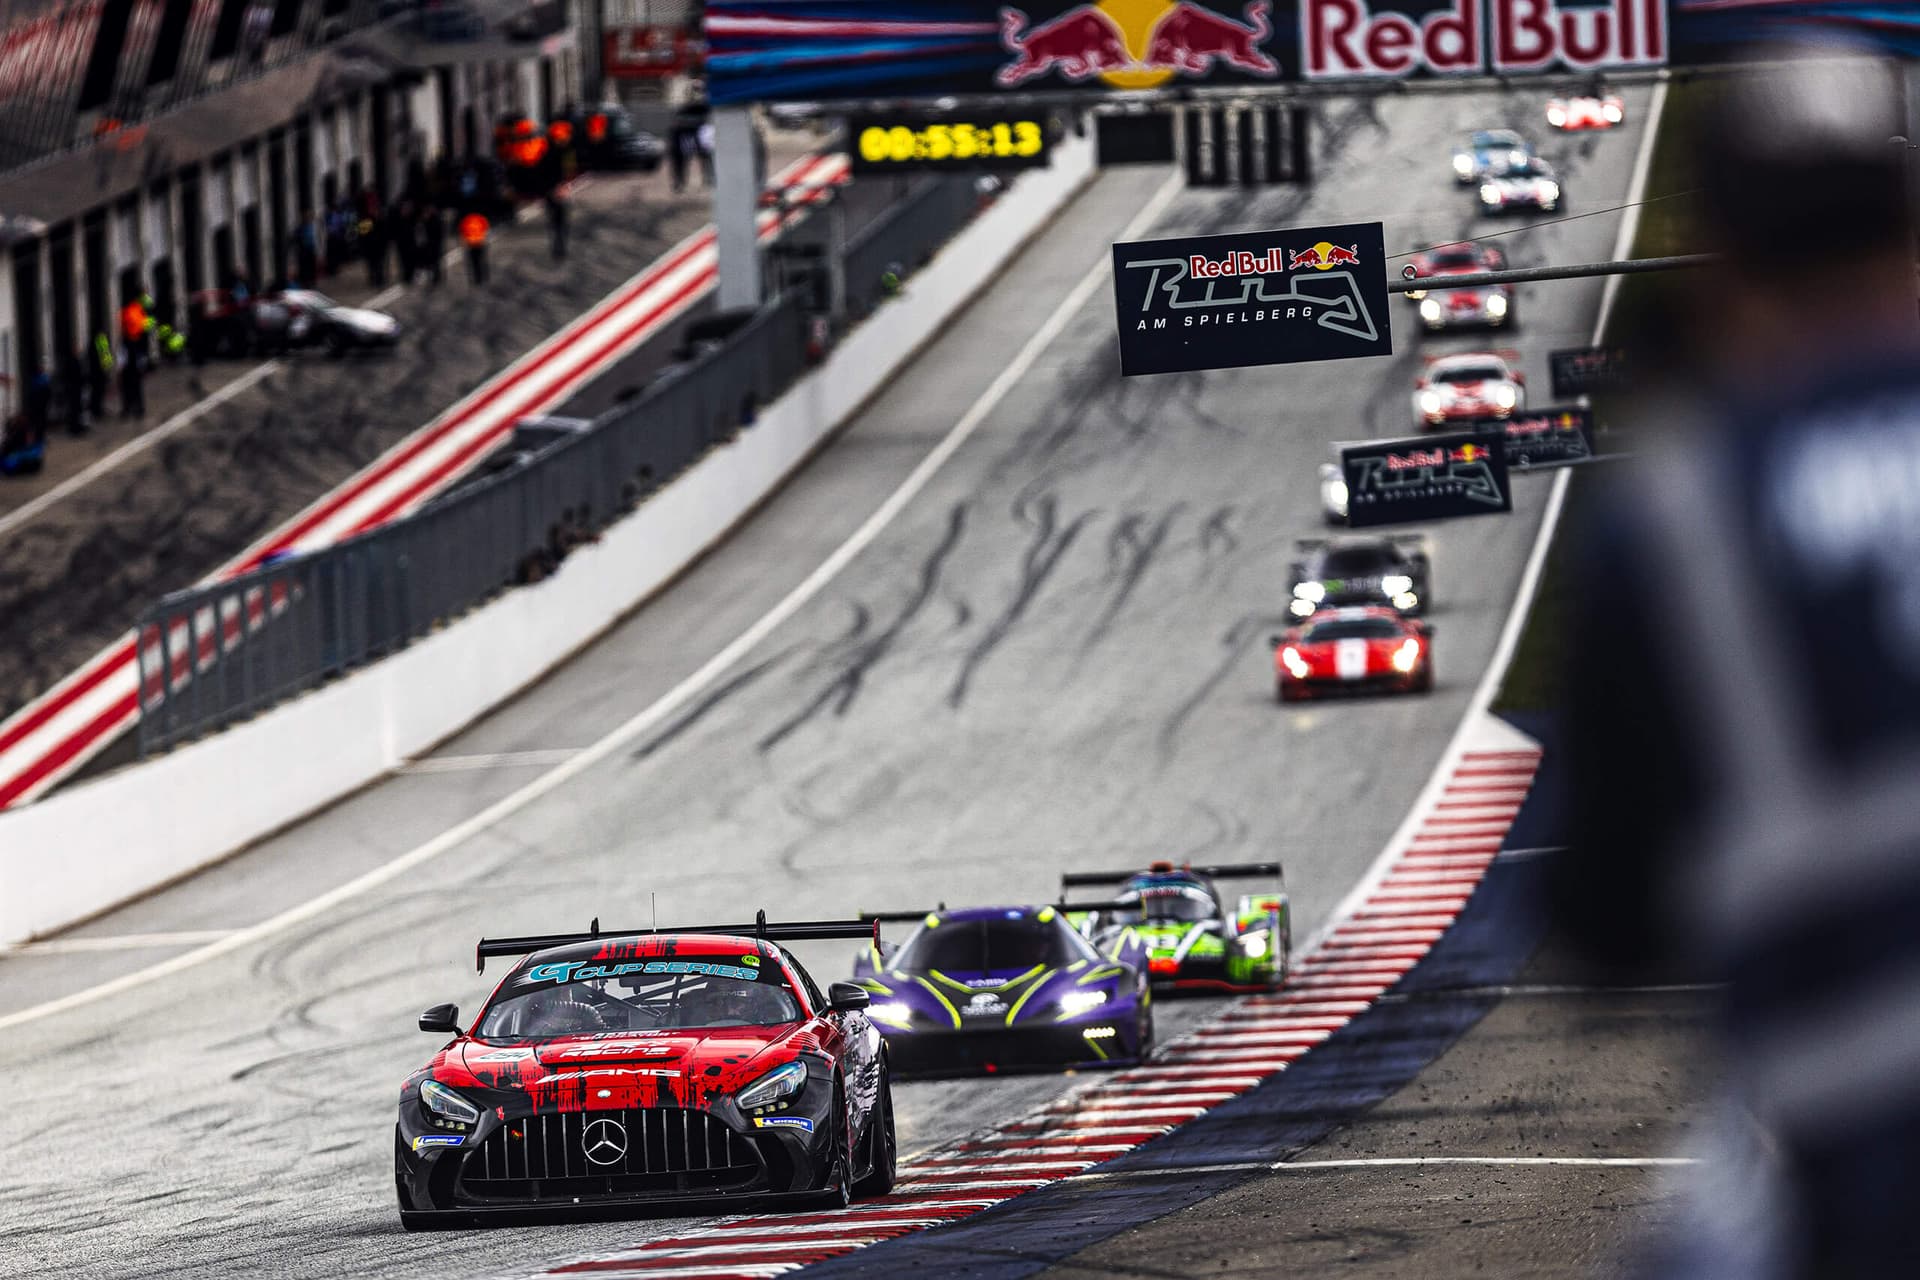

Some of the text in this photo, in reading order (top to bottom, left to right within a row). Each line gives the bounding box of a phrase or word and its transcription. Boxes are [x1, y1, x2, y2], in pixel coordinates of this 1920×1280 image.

[1304, 0, 1664, 74] Red Bull
[860, 121, 1042, 161] 00:55:13
[1190, 248, 1283, 279] Red Bull
[1137, 306, 1313, 331] AM SPIELBERG
[528, 960, 760, 984] GT CUP SERIES
